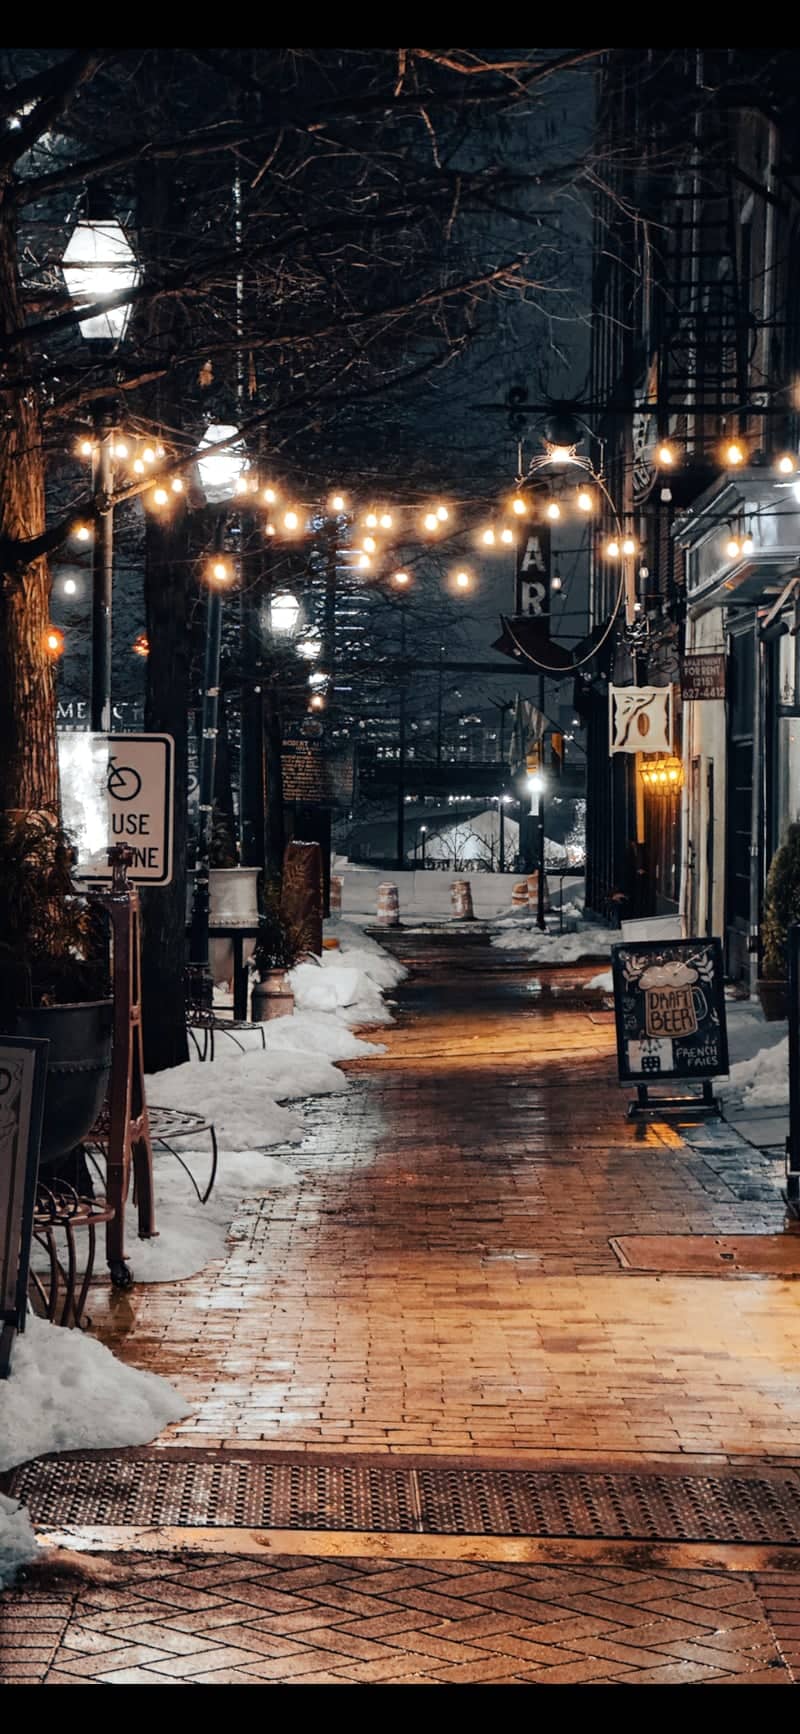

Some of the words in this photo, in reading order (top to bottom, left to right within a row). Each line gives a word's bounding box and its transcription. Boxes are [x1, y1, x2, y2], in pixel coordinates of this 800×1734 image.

[684, 666, 700, 677] FOR
[701, 665, 720, 676] RENT
[692, 676, 714, 688] (215)
[682, 687, 726, 699] 627-4412
[112, 813, 150, 835] USE
[650, 990, 689, 1010] DRAFT
[651, 1008, 693, 1032] BEER
[675, 1045, 719, 1058] FRENCH
[687, 1056, 719, 1067] FRIES
